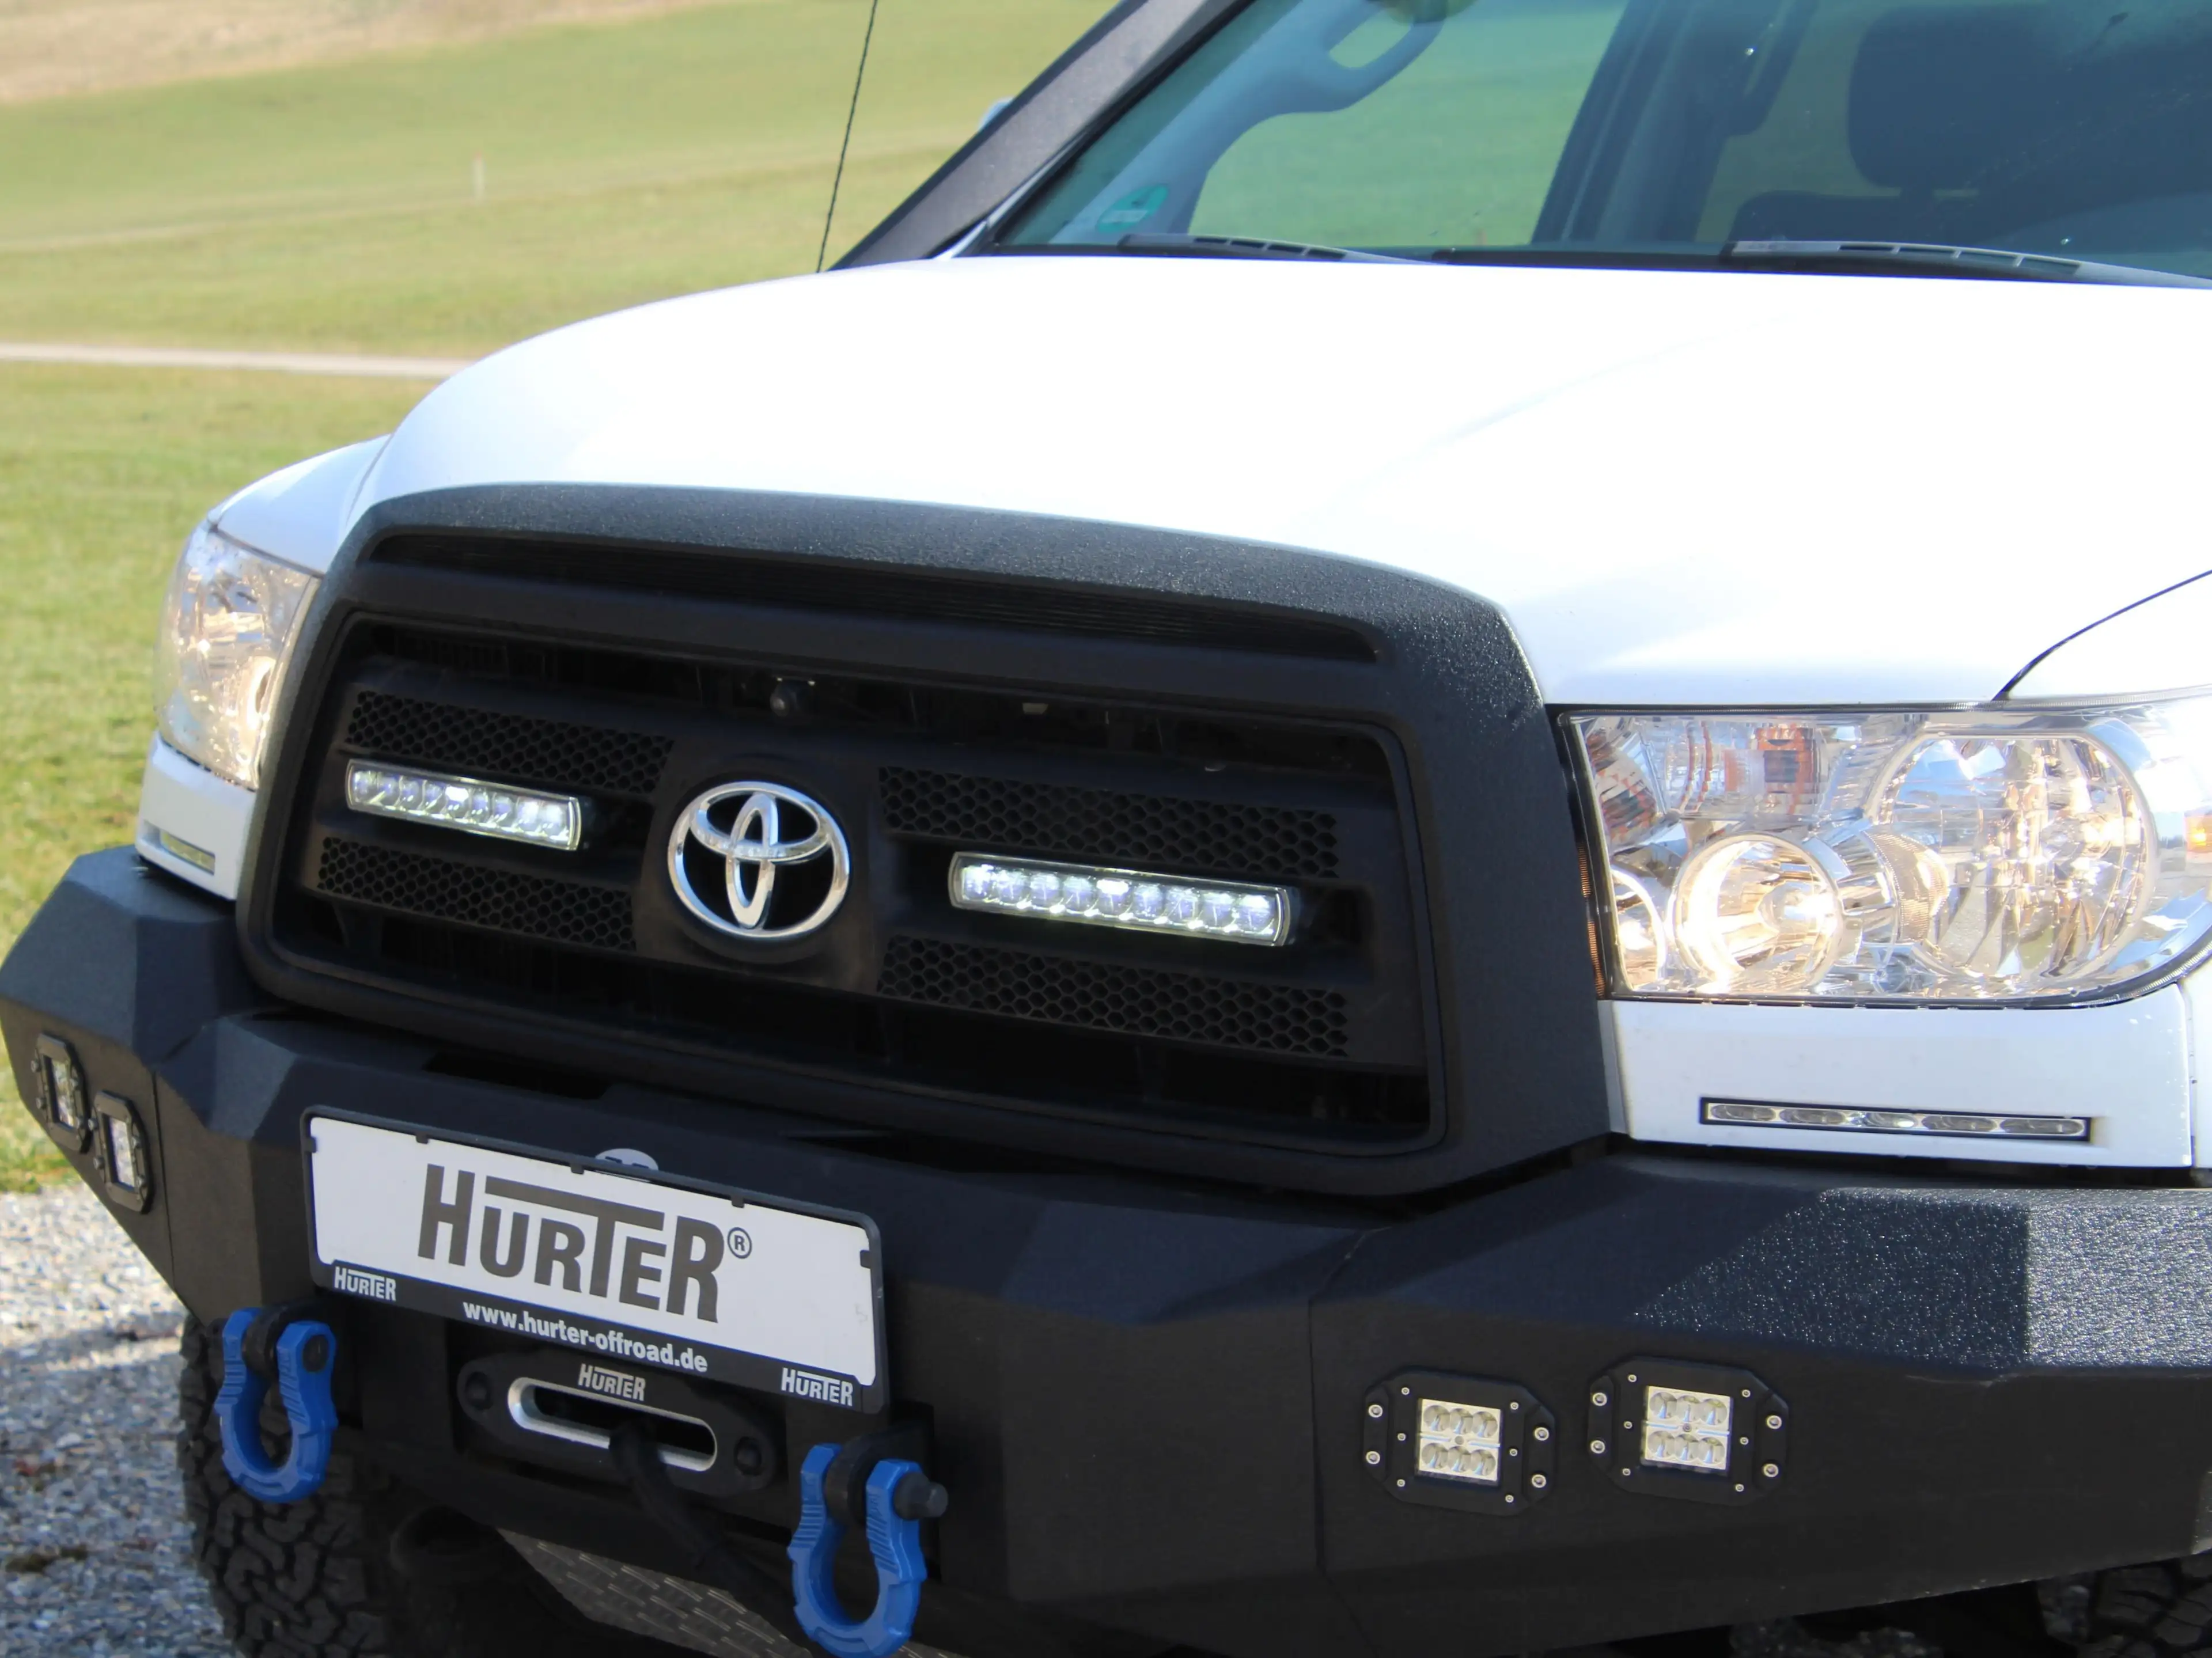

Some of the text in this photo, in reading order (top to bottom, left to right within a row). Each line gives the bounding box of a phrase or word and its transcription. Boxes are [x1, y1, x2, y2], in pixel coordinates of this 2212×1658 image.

[334, 1266, 396, 1301] HURTER
[463, 1302, 708, 1372] www.hurter-offroad.de
[578, 1363, 646, 1401] HURTER
[781, 1367, 853, 1406] HURTER
